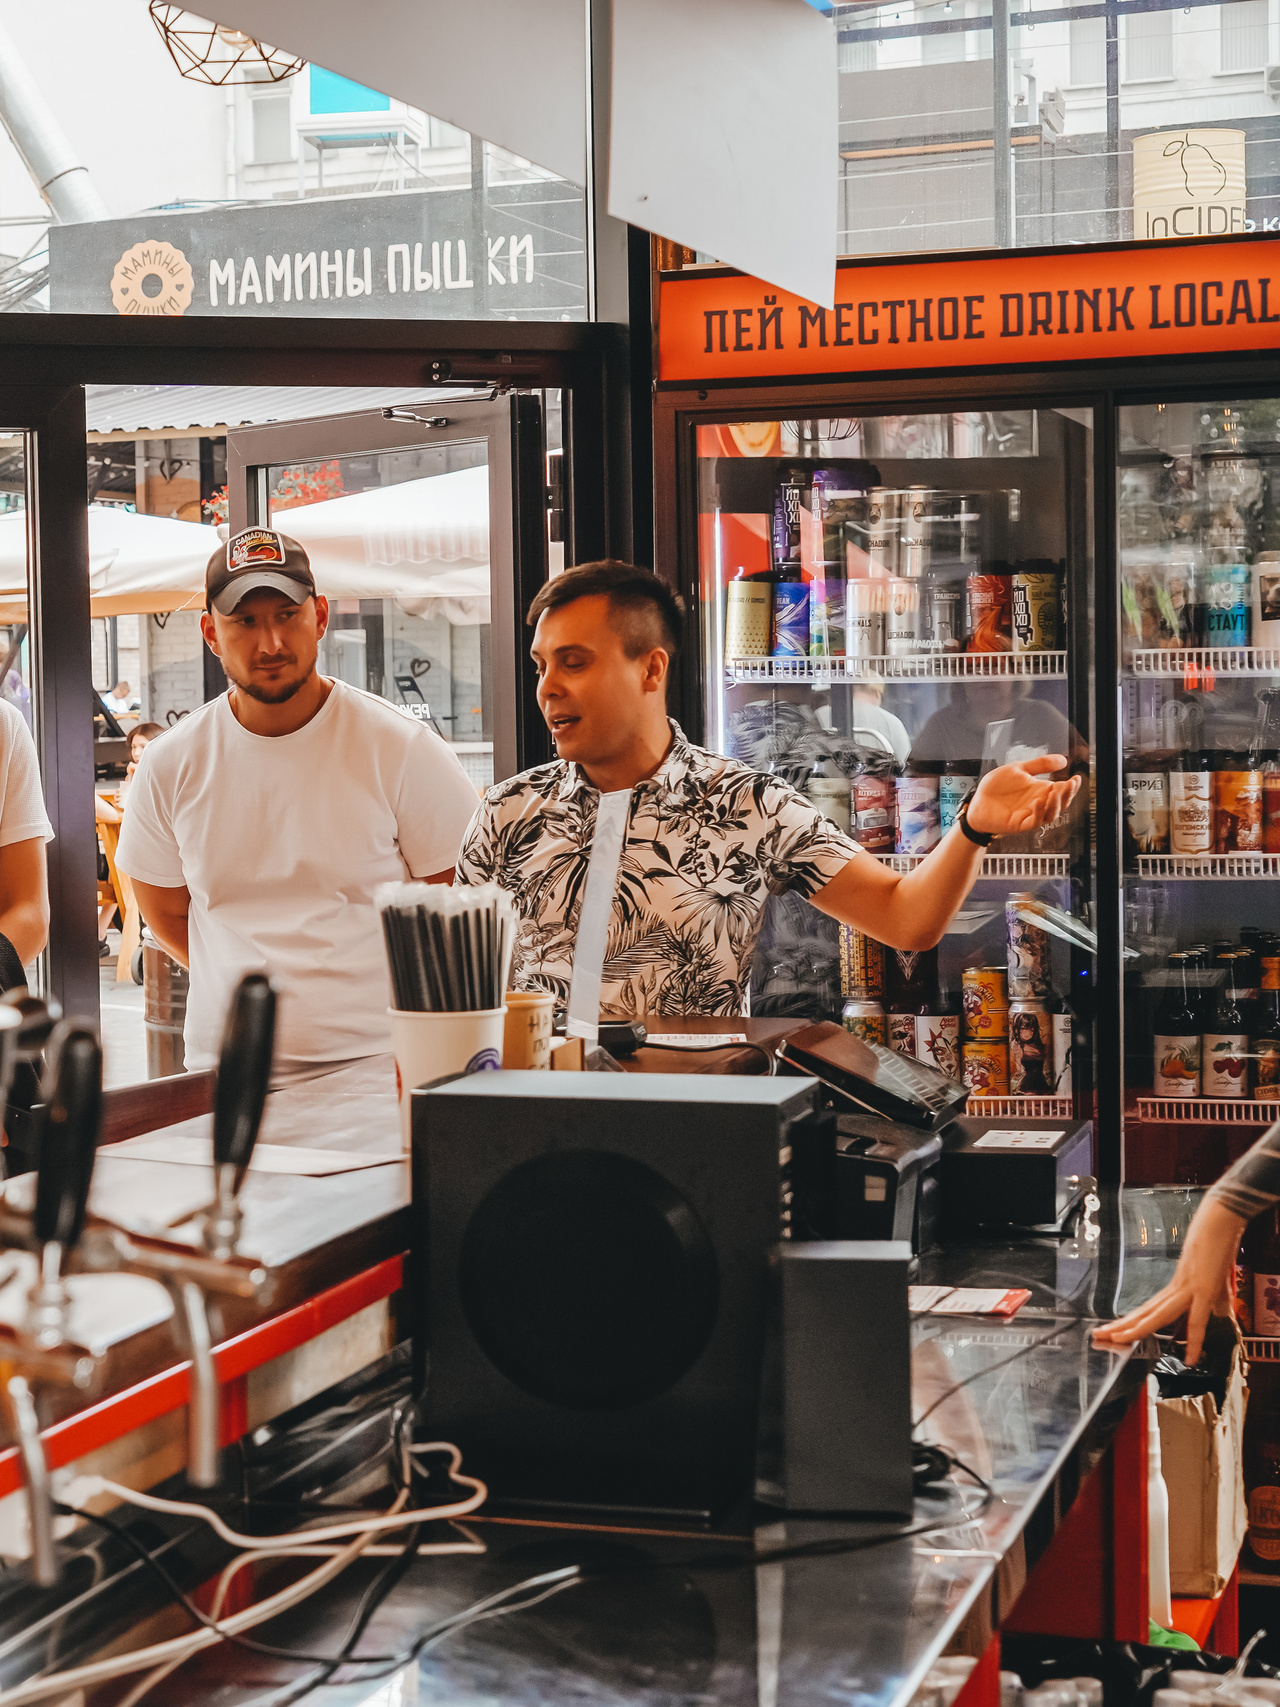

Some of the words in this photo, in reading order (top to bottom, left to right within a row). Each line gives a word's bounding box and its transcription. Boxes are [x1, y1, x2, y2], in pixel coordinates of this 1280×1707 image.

[1146, 205, 1248, 239] InCIDE
[120, 248, 184, 281] МАМИНЫ
[209, 246, 373, 307] МАМИНЫ
[999, 285, 1135, 338] DRINK
[1148, 277, 1280, 330] LOCAL
[703, 295, 784, 353] ПЕЙ
[798, 294, 985, 348] МЕСТНОЕ
[235, 531, 273, 546] CANADIAN
[1013, 588, 1024, 603] ЙО
[1015, 602, 1026, 615] ХО
[1016, 614, 1028, 626] ХО
[1207, 614, 1245, 631] СТАУТ
[1131, 779, 1164, 791] БРИЗ
